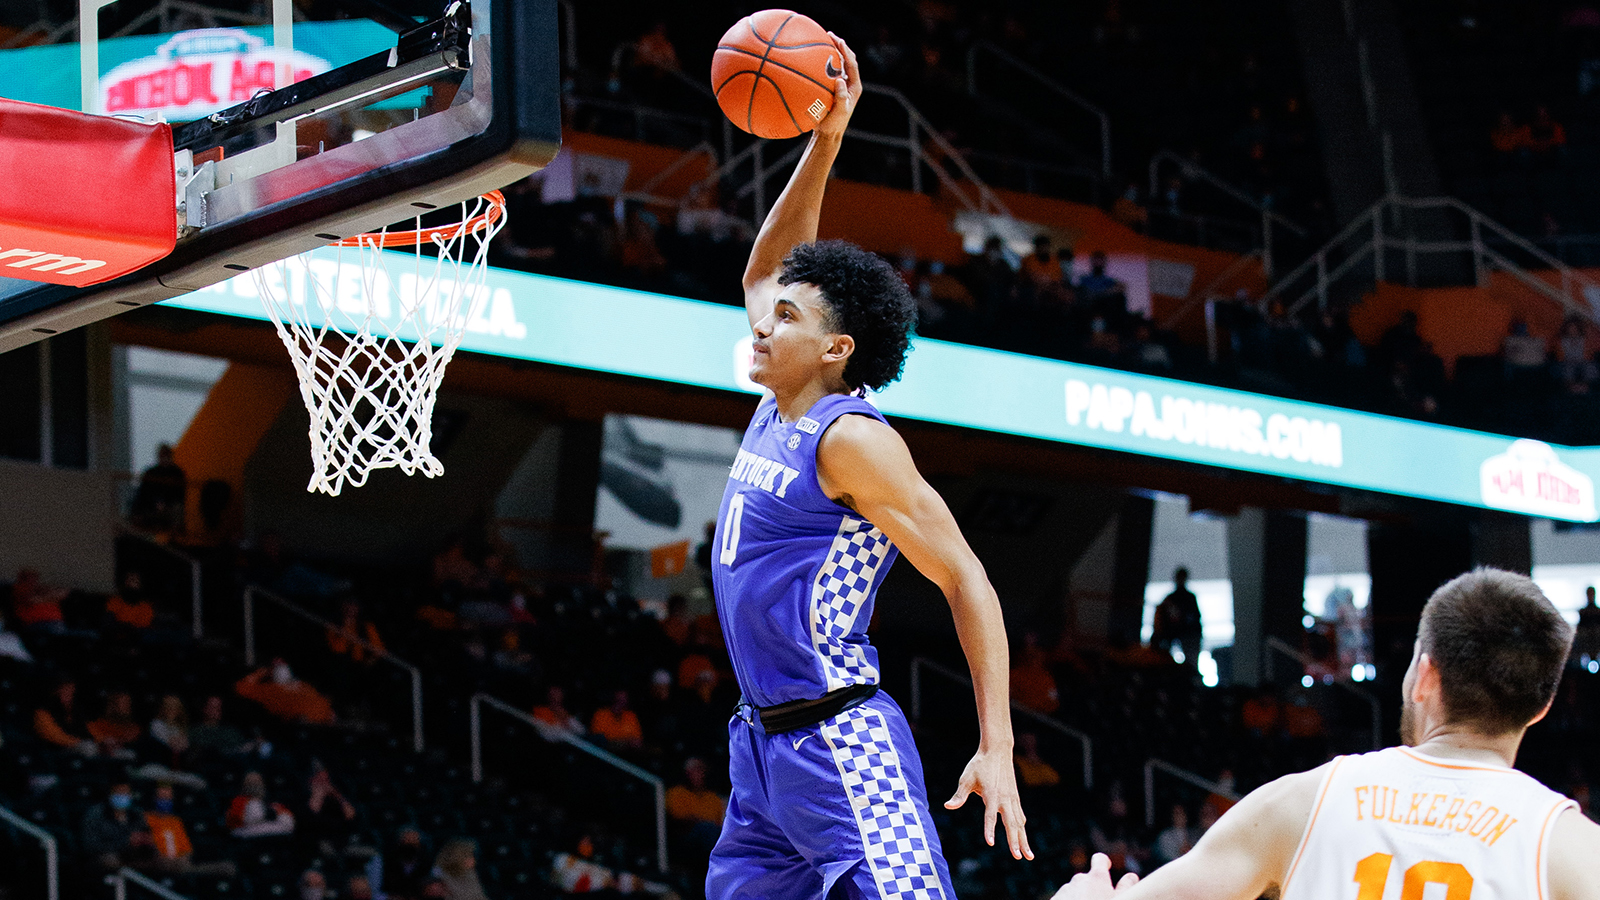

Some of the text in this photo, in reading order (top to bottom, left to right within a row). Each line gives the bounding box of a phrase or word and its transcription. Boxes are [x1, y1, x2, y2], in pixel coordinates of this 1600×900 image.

[0, 247, 107, 275] rm
[1065, 380, 1343, 468] PAPAJOHNS.COM
[729, 447, 800, 499] ENTUCKY
[720, 492, 744, 566] 0
[1355, 785, 1518, 847] FULKERSON
